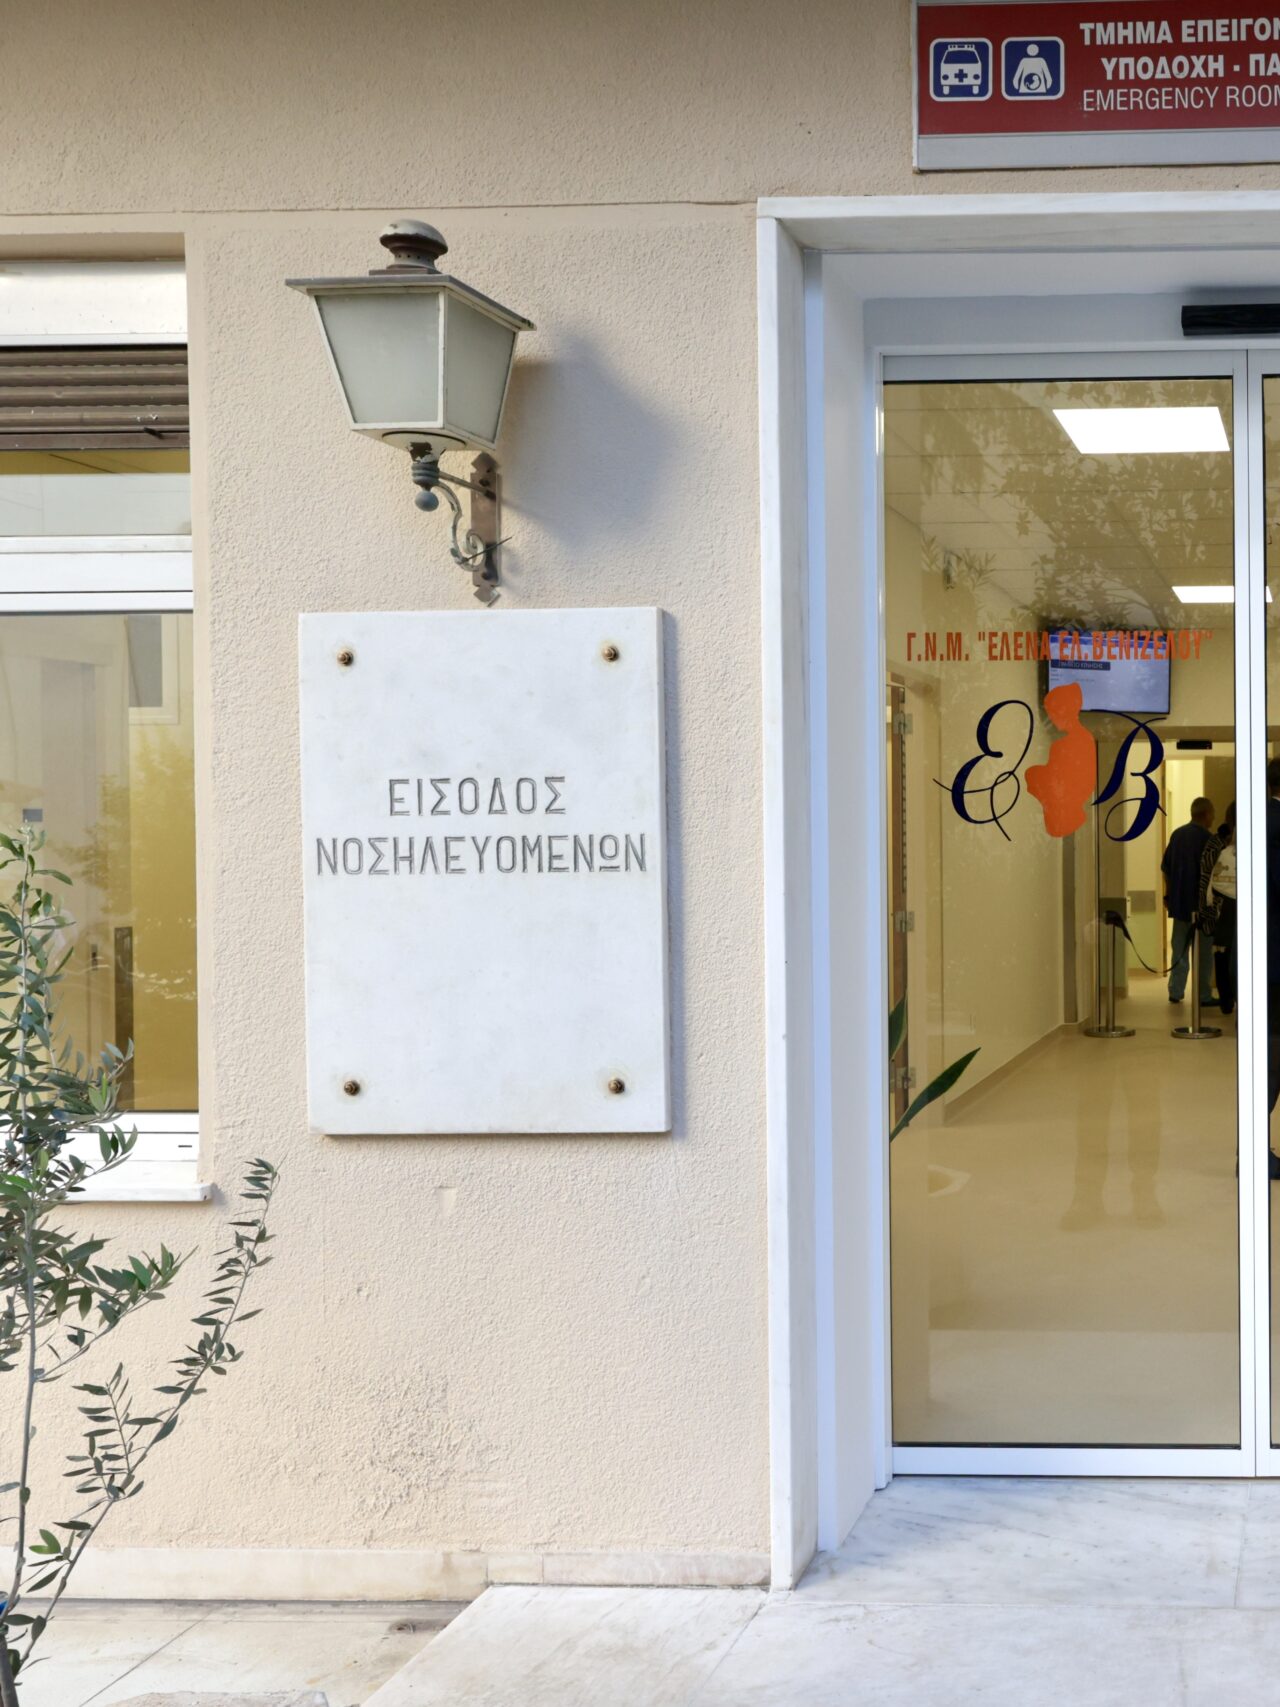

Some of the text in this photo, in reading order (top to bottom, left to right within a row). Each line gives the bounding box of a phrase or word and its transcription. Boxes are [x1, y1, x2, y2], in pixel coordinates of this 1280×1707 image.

[1080, 20, 1173, 45] ΤΜΗΜΑ
[1101, 54, 1225, 80] ΥΠΟΔΟΧΗ
[1083, 86, 1219, 111] EMERGENCY
[906, 631, 969, 661] Γ.Ν.Μ.
[978, 630, 1049, 661] "ΕΛΕΝΑ
[387, 776, 566, 817] ΕΙΣΟΔΟΣ
[316, 833, 647, 876] ΝΟΣΗΛΕΥΟΜΕΝΩΝ
